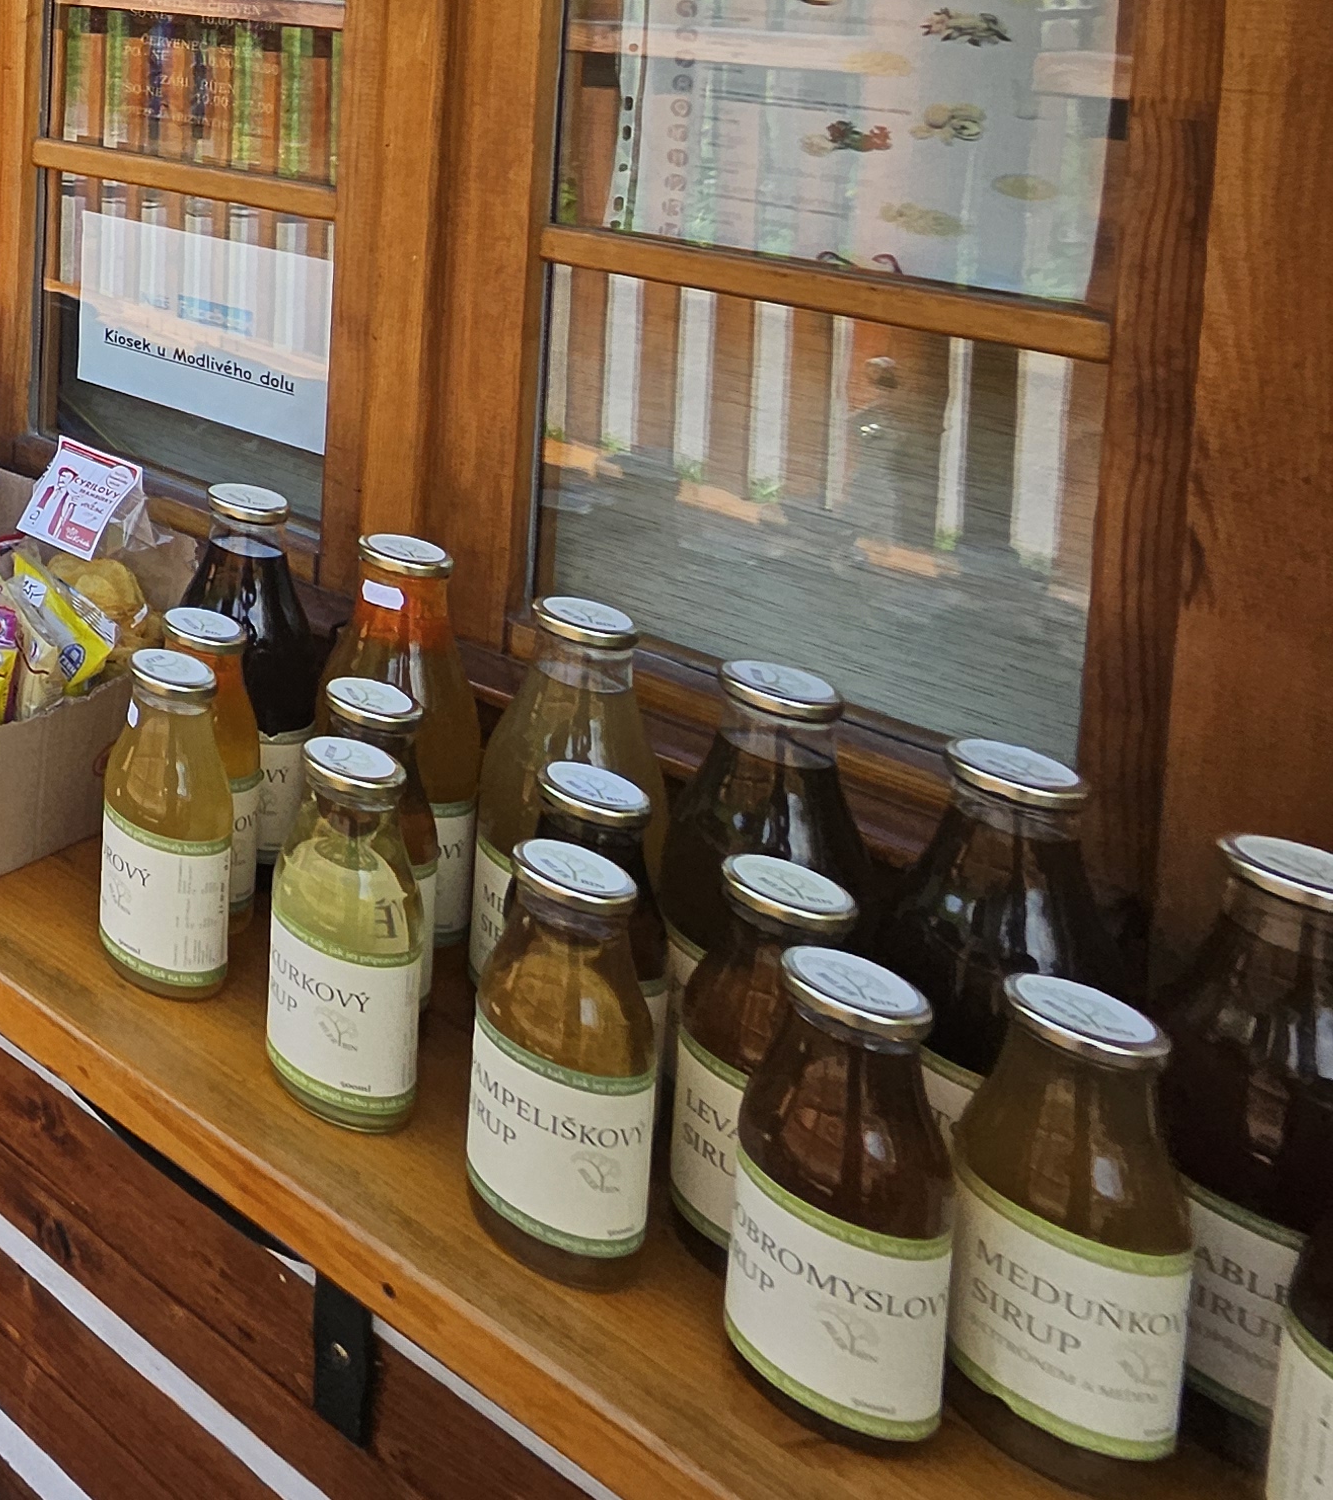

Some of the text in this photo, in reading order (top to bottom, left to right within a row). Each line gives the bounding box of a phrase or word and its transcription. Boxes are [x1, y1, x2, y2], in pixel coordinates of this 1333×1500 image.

[105, 327, 295, 393] Kiosek u Modlivého dolu
[473, 1060, 646, 1149] AMPELIŠKOVÝ
[970, 1276, 1082, 1355] SIRUP
